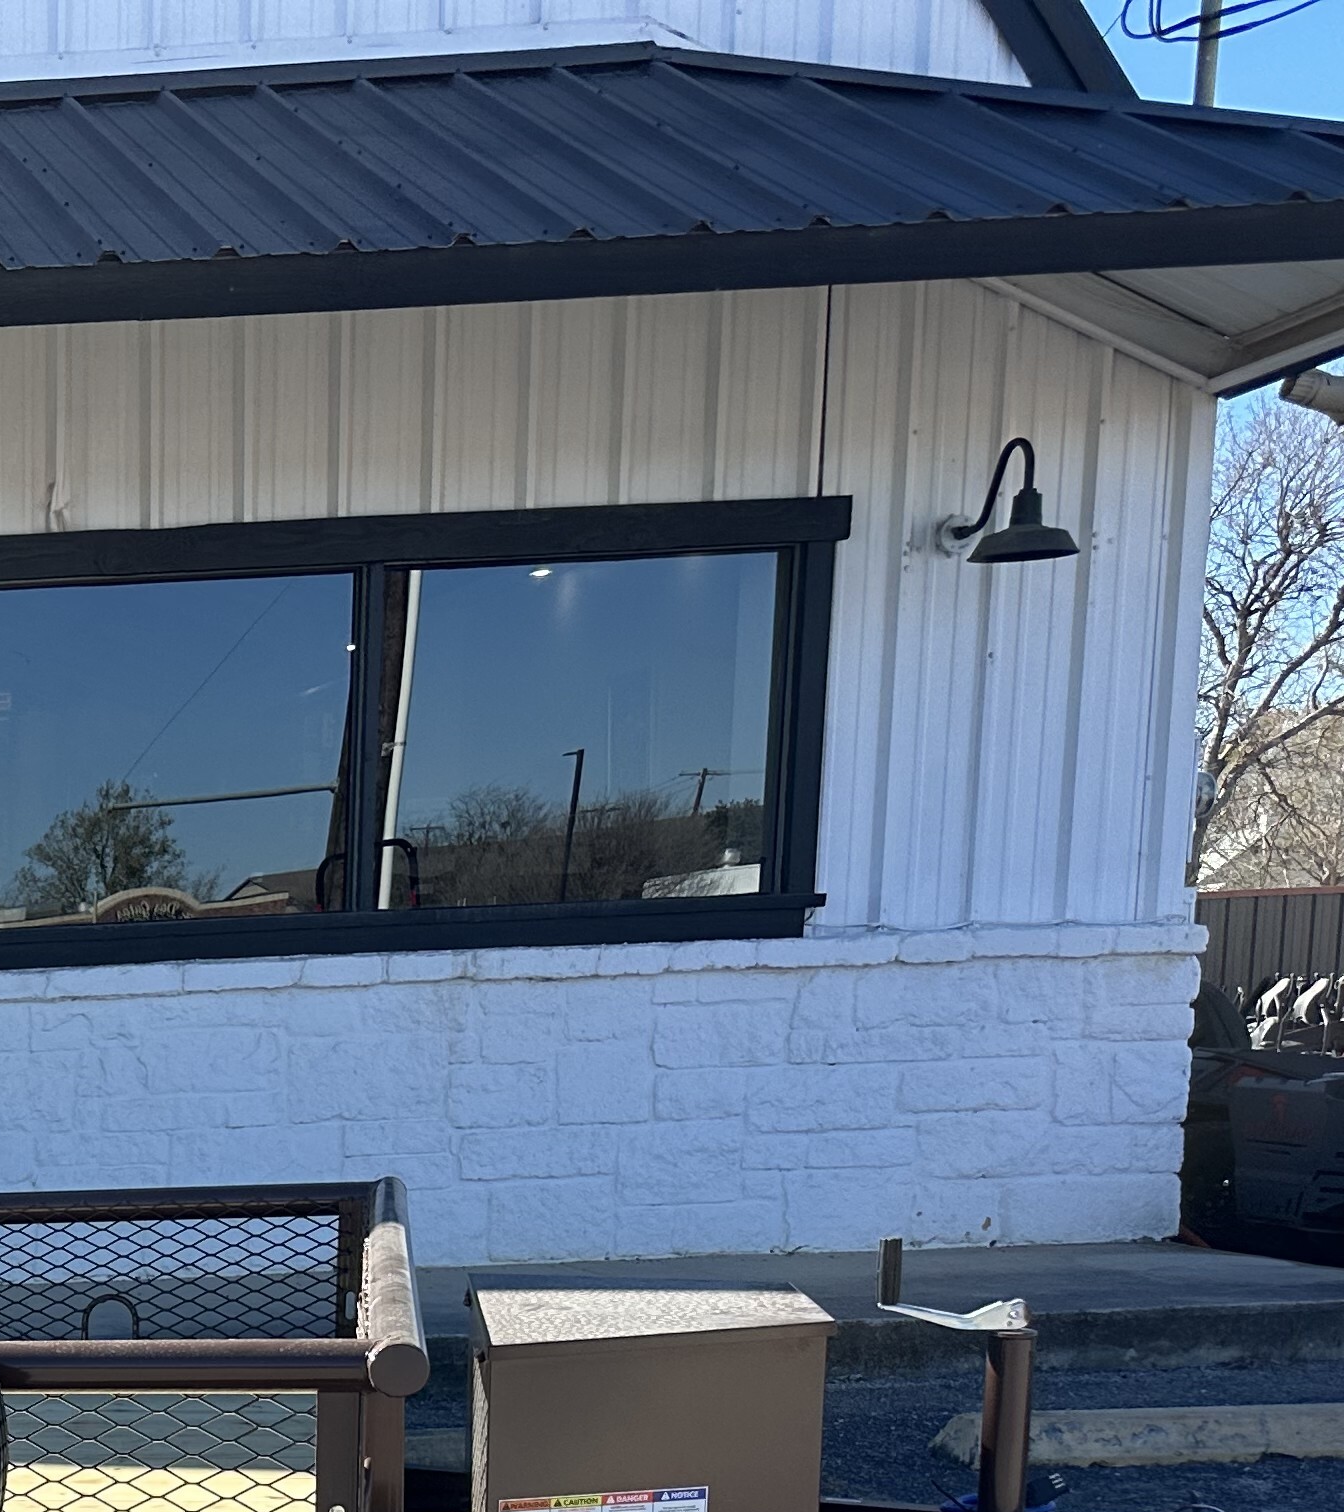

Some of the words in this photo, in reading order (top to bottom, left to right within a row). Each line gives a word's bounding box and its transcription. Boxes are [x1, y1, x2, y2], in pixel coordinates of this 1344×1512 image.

[616, 1495, 648, 1503] DANGER
[671, 1491, 699, 1499] NOTICE
[563, 1498, 598, 1506] CAUTION
